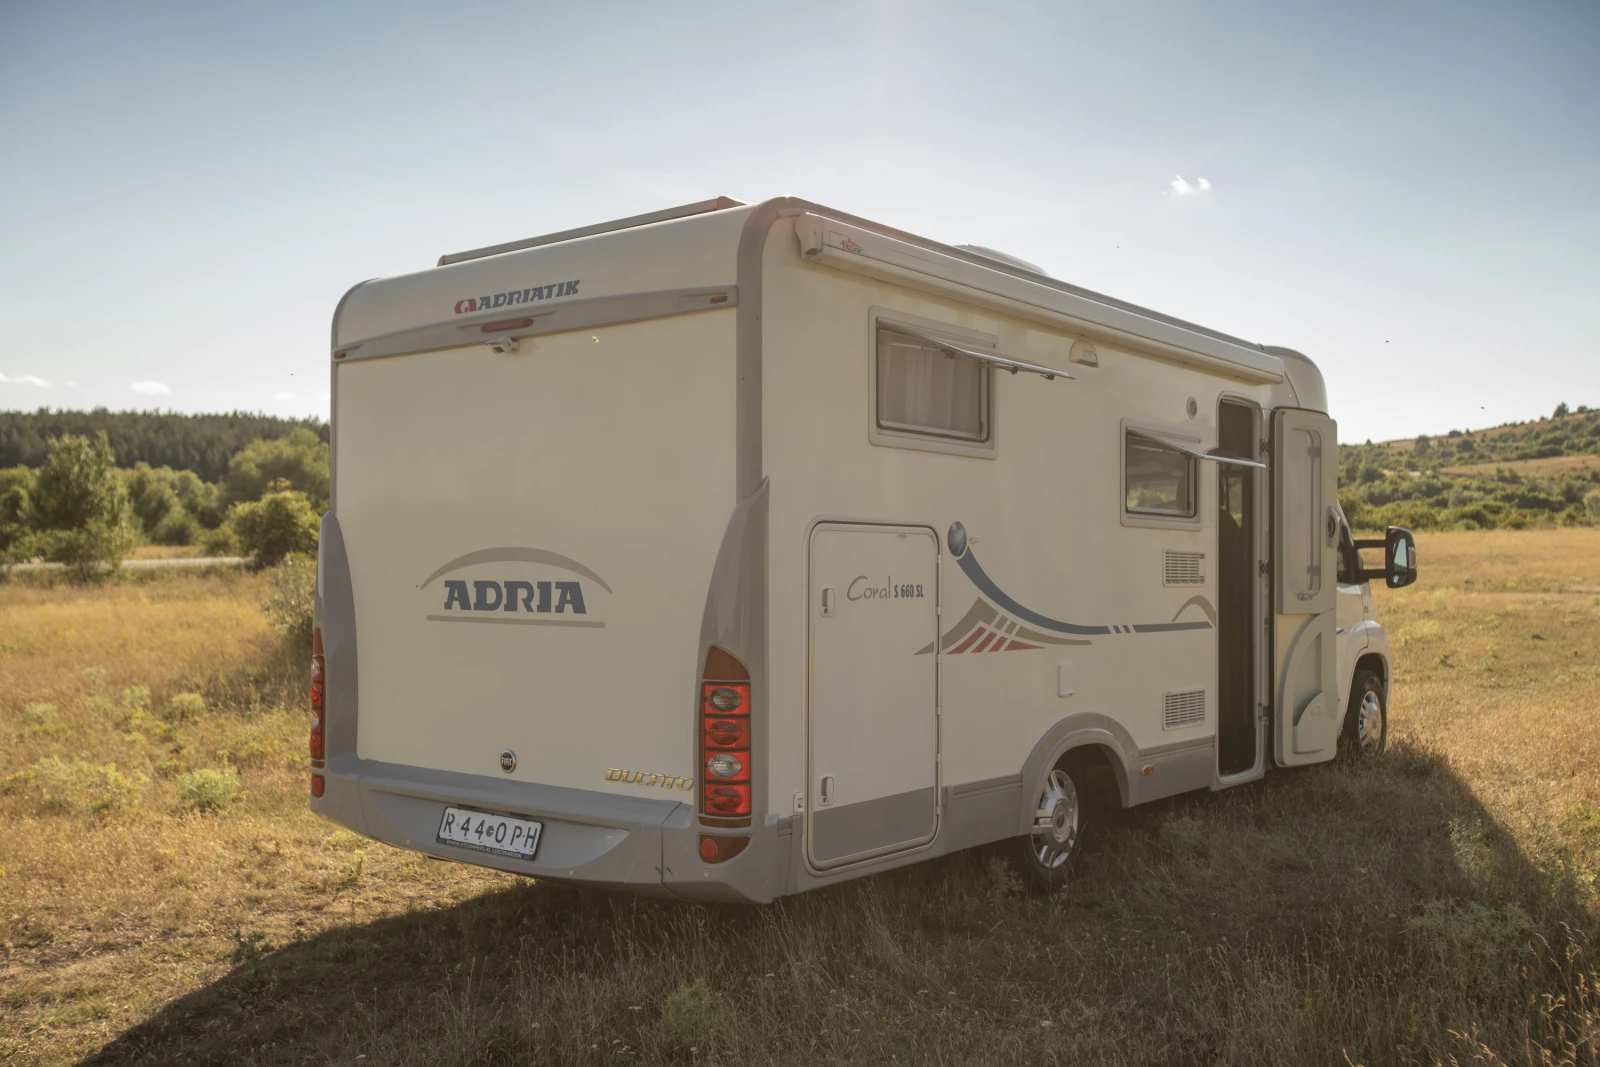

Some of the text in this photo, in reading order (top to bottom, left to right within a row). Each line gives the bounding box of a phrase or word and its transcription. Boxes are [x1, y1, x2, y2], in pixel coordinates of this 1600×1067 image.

[478, 279, 580, 311] ADRIATIK
[444, 579, 587, 614] ADRIA
[846, 575, 924, 601] Coral S 660 SL
[605, 767, 694, 791] DUCATO
